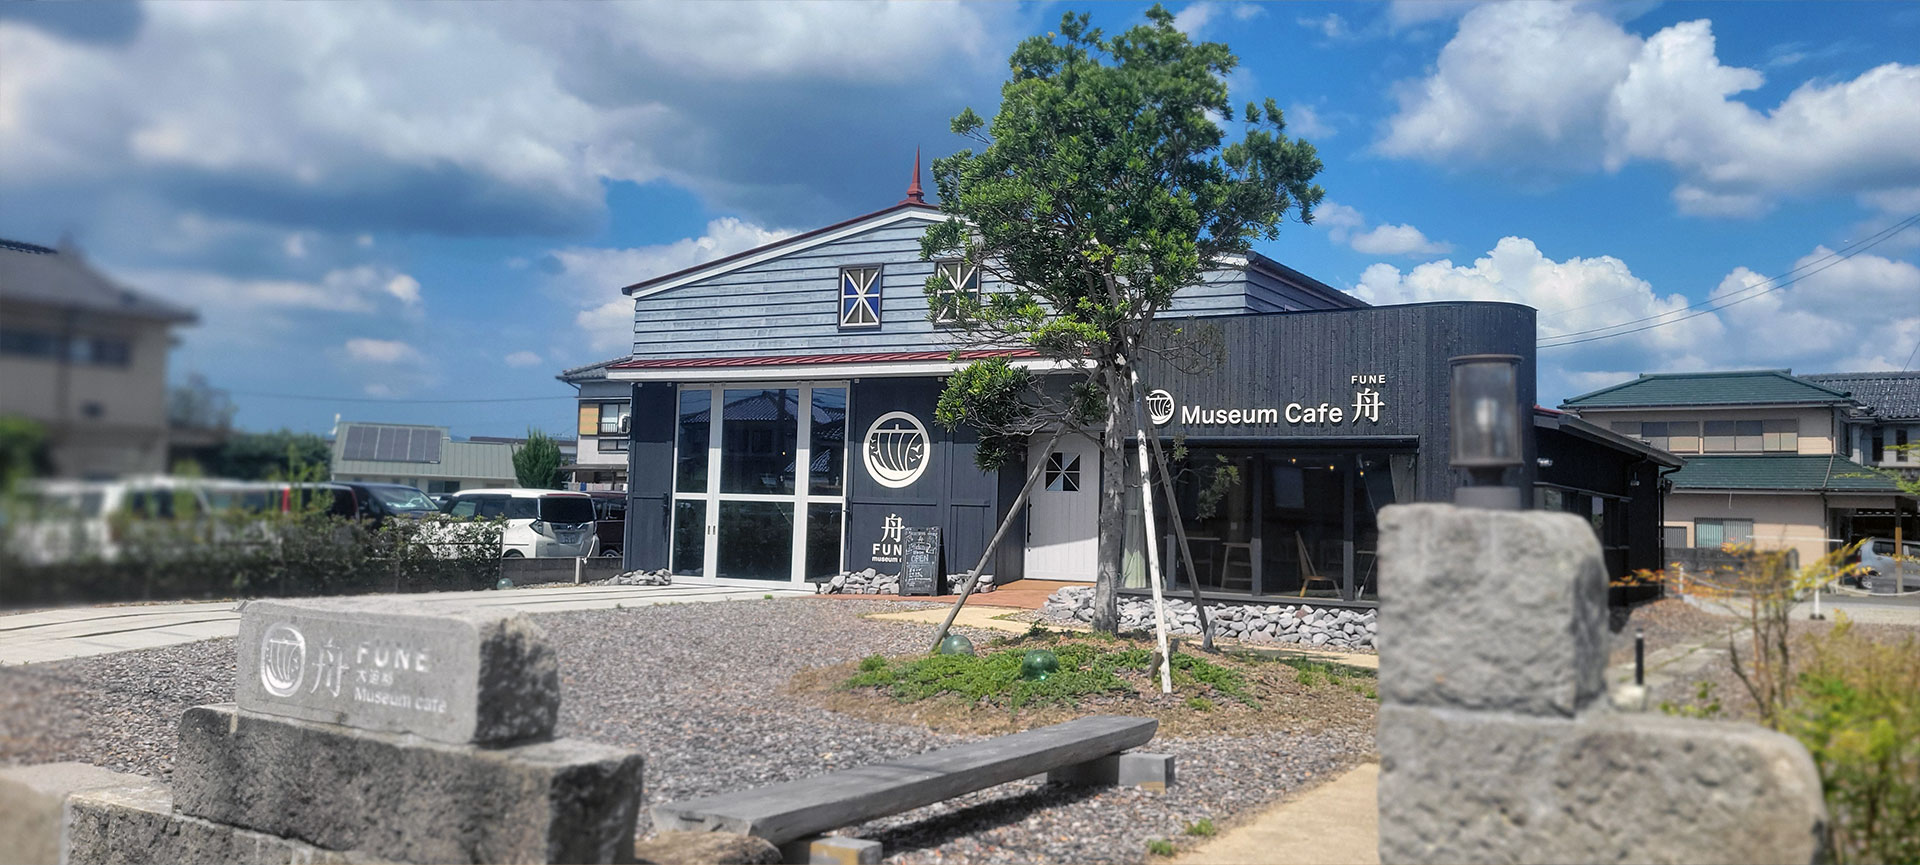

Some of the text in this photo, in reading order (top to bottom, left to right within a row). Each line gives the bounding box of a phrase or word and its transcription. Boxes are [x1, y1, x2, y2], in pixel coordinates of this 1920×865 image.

[1350, 375, 1386, 384] FUNE
[1181, 402, 1343, 425] Museum Cafe
[1351, 387, 1386, 423] 舟
[880, 513, 906, 543] 舟
[872, 543, 902, 556] FUN
[310, 636, 350, 698] 舟
[356, 641, 431, 673] FUNE
[354, 687, 448, 714] Museum cafe
